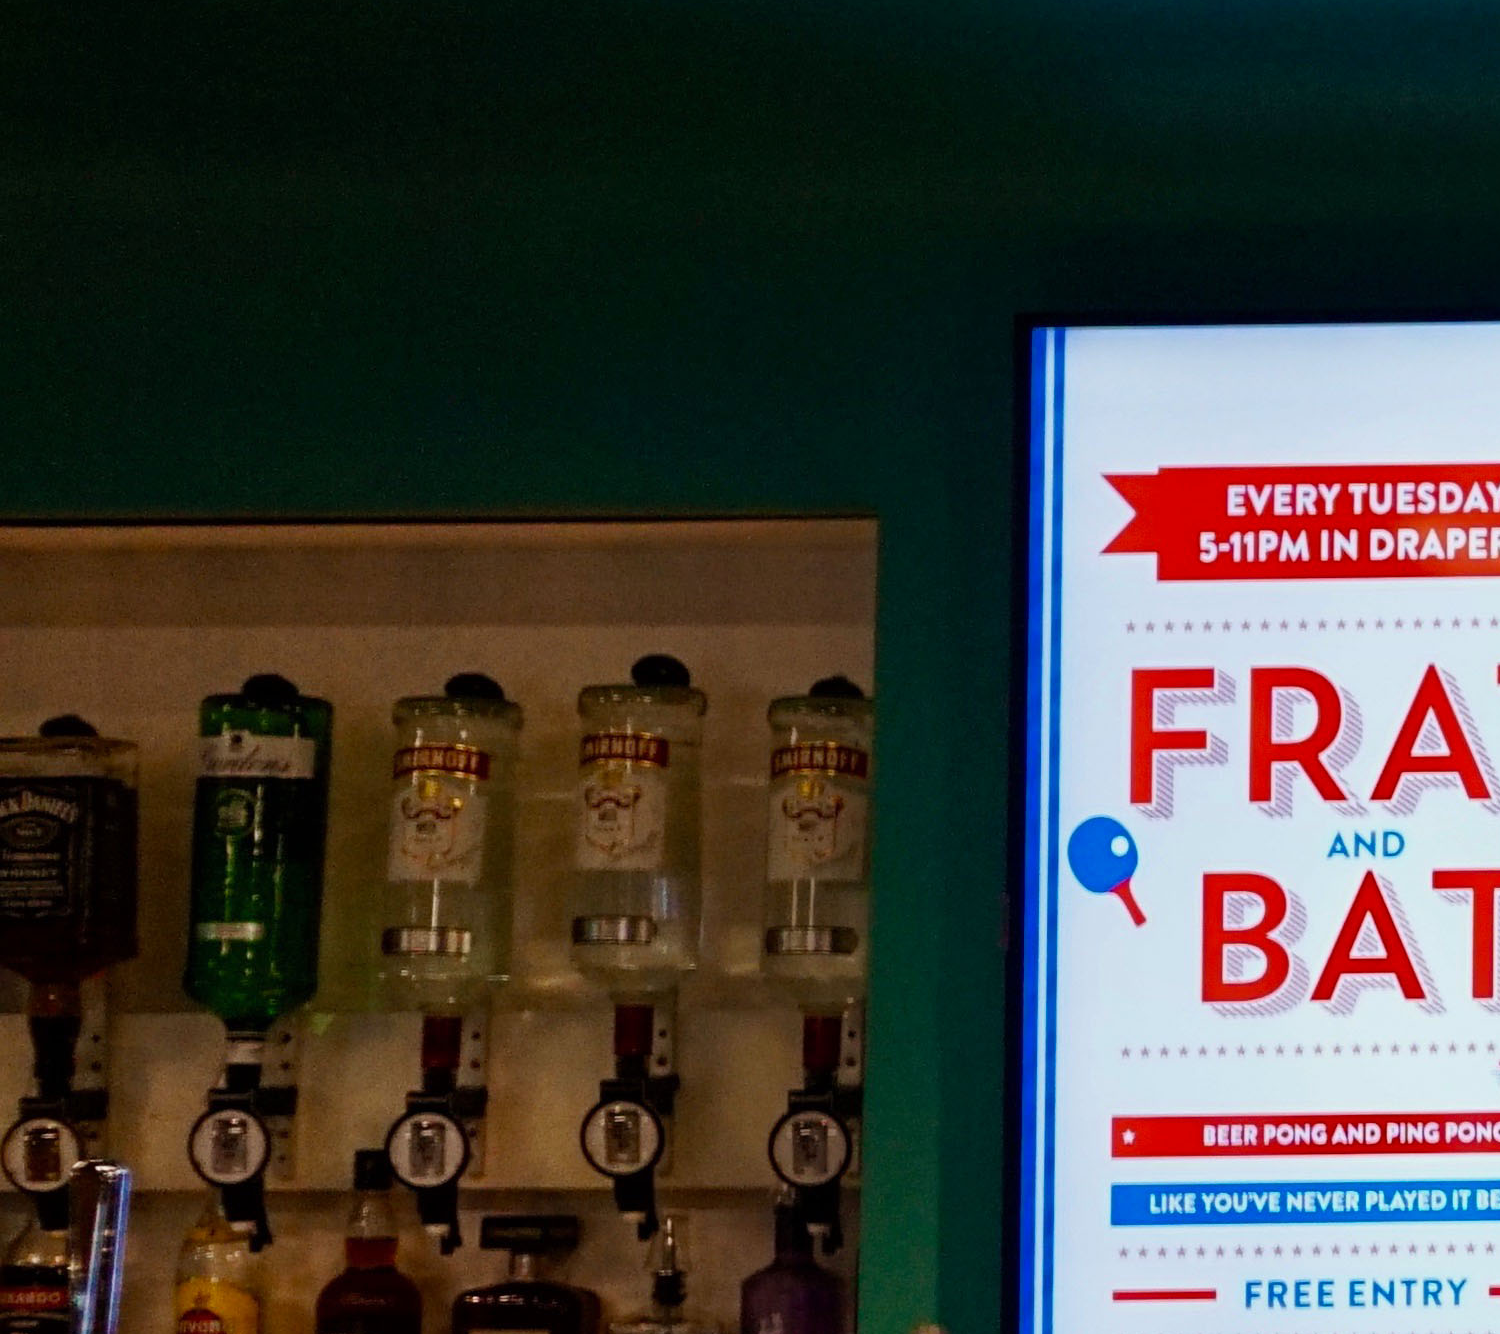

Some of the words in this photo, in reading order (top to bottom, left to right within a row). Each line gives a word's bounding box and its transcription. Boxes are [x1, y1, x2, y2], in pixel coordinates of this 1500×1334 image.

[1226, 483, 1343, 517] EVERY
[1199, 528, 1311, 563] 5-11PM
[1319, 529, 1359, 561] IN
[1327, 830, 1406, 859] AND
[1203, 1124, 1257, 1147] BEER
[1263, 1123, 1327, 1146] PONG
[1331, 1123, 1382, 1145] AND
[1385, 1121, 1440, 1144] PING
[1149, 1193, 1197, 1216] LIKE
[1201, 1191, 1281, 1214] YOU'VE
[1286, 1190, 1359, 1213] NEVER
[1365, 1189, 1448, 1212] PLAYED
[1451, 1188, 1473, 1210] IT
[1244, 1279, 1336, 1310] FREE
[1348, 1277, 1469, 1308] ENTRY
